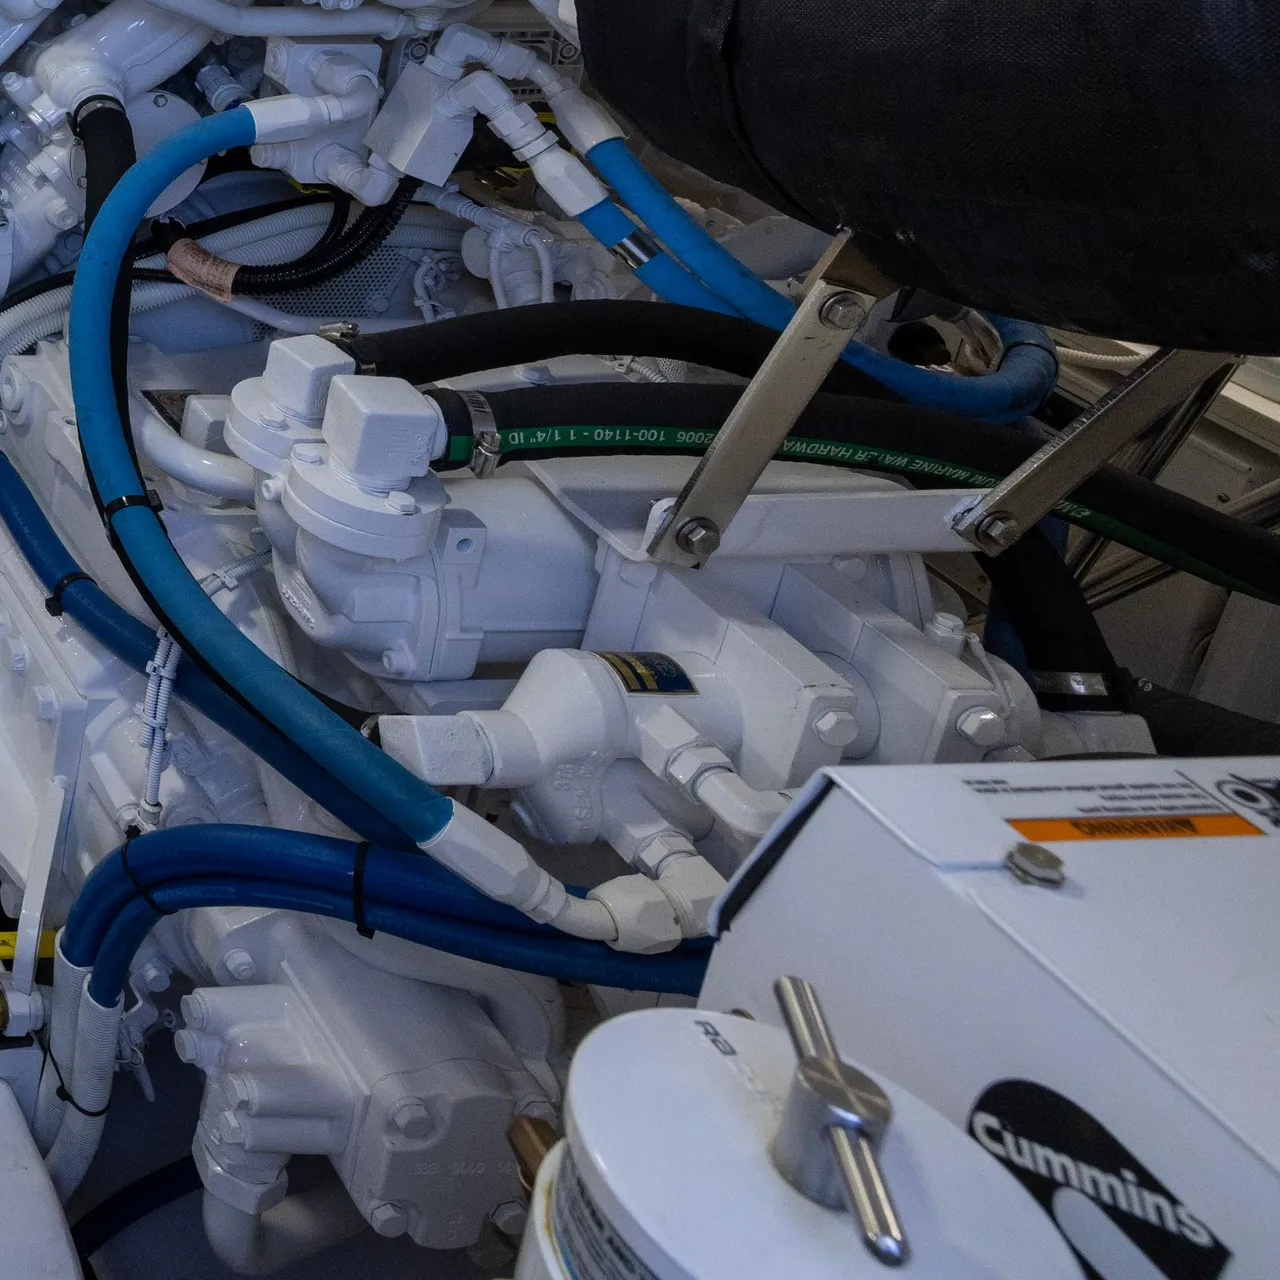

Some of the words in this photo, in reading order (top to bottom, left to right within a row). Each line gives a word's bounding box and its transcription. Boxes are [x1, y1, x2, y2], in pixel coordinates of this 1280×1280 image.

[509, 431, 524, 444] ID
[594, 429, 665, 442] 100-1140
[676, 430, 715, 444] 2006
[783, 439, 854, 457] HARDWA
[909, 459, 969, 480] MARINE
[971, 1110, 1214, 1248] Cummins
